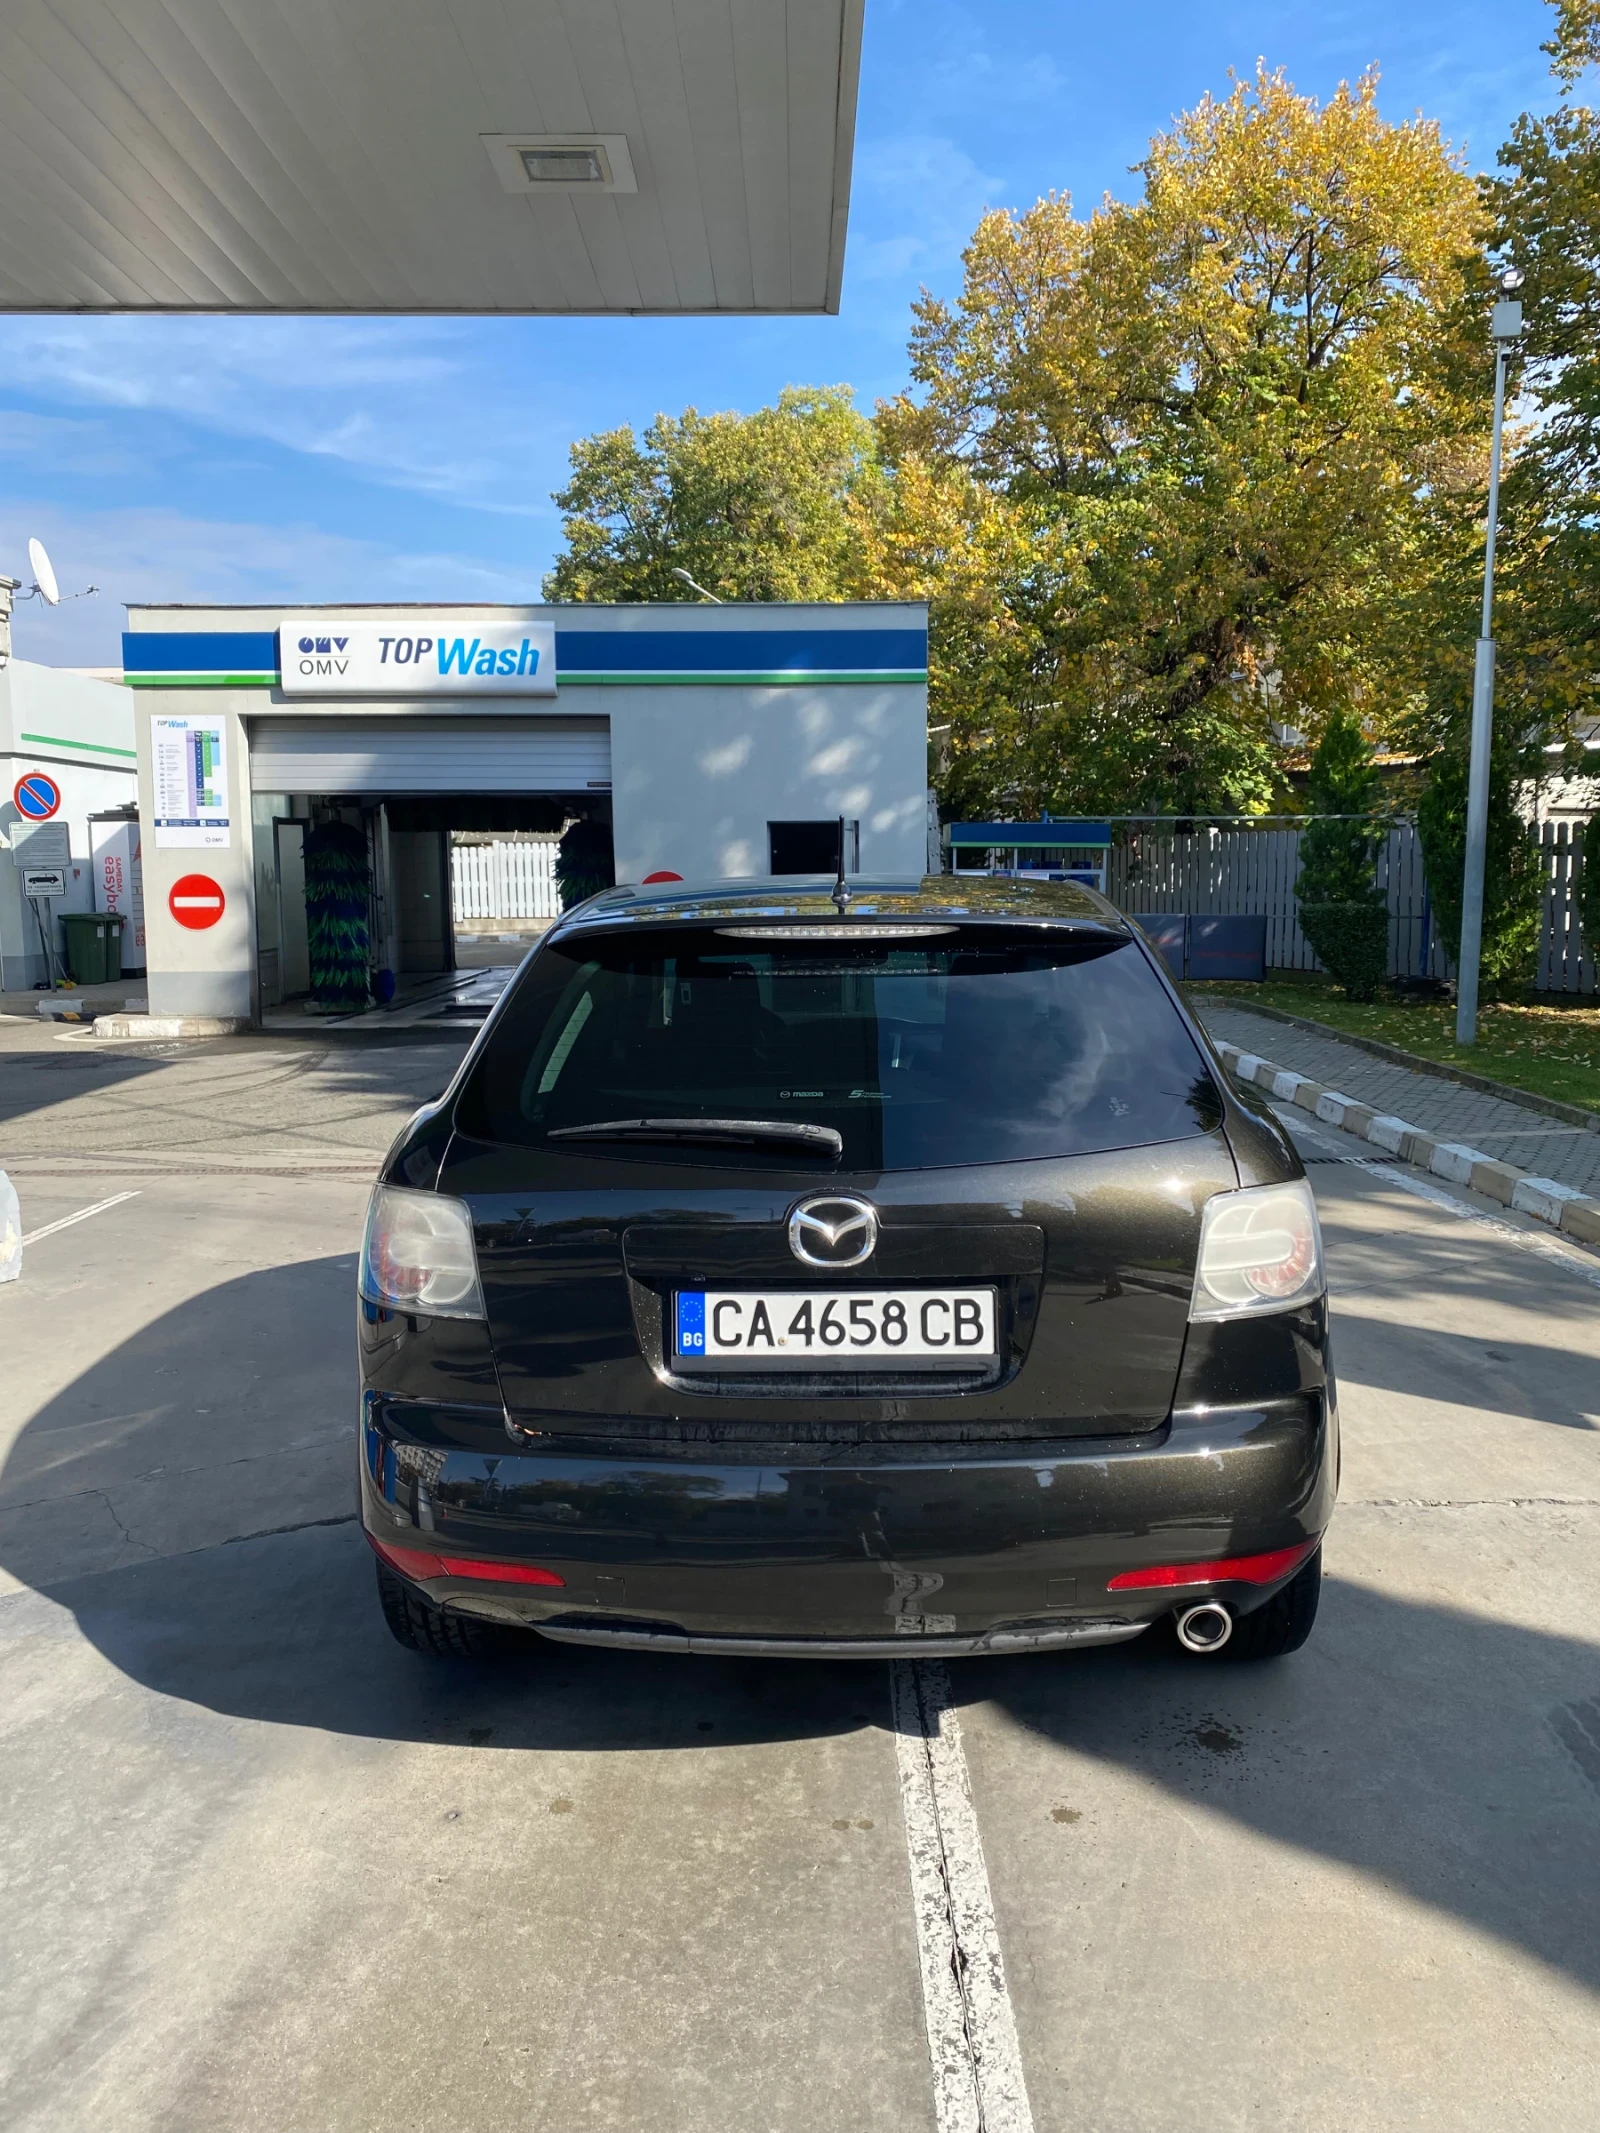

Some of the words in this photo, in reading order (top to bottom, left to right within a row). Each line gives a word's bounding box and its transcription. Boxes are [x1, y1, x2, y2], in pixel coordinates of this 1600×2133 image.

[299, 660, 349, 675] OMV
[437, 638, 540, 676] Wash
[168, 720, 188, 728] Wash
[103, 856, 118, 912] easybo
[115, 857, 123, 893] SAMEDAY
[682, 1332, 703, 1347] BG
[713, 1299, 775, 1347] CA
[788, 1299, 908, 1347] 4658
[920, 1298, 984, 1346] CB
